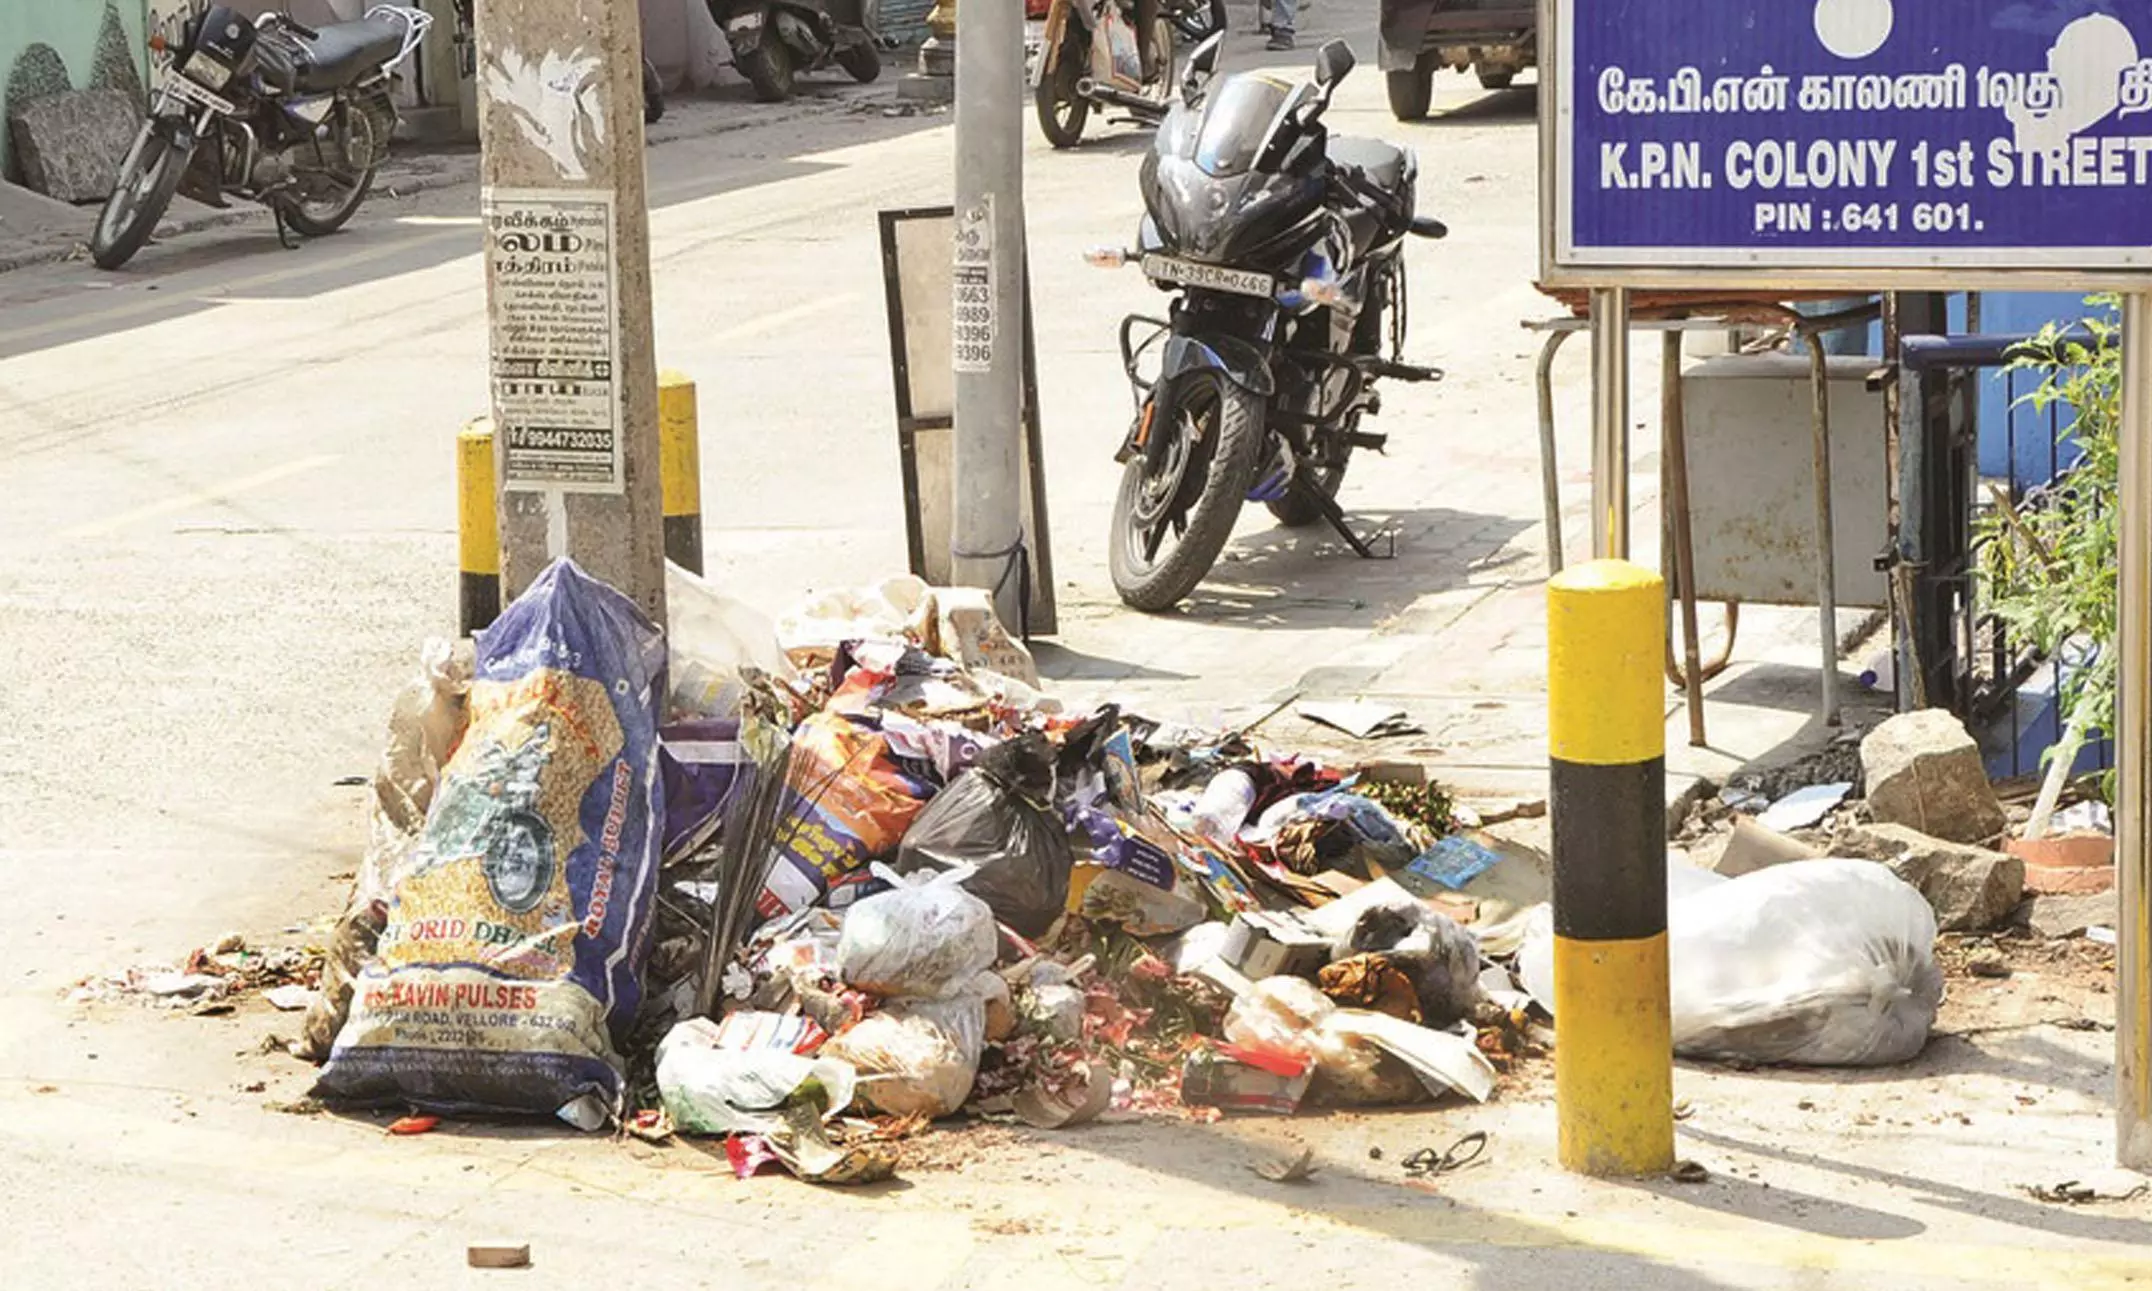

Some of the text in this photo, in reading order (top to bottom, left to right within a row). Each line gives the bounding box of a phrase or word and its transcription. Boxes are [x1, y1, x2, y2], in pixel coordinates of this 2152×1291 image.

[1599, 64, 1790, 113] கே.பி.என்
[1798, 63, 1966, 111] காலணி
[1600, 136, 2152, 189] K.P.N. COLONY 1st STREET
[1755, 202, 1811, 232] PIN
[456, 984, 538, 1010] PULSES
[455, 1013, 518, 1028] VELLORE
